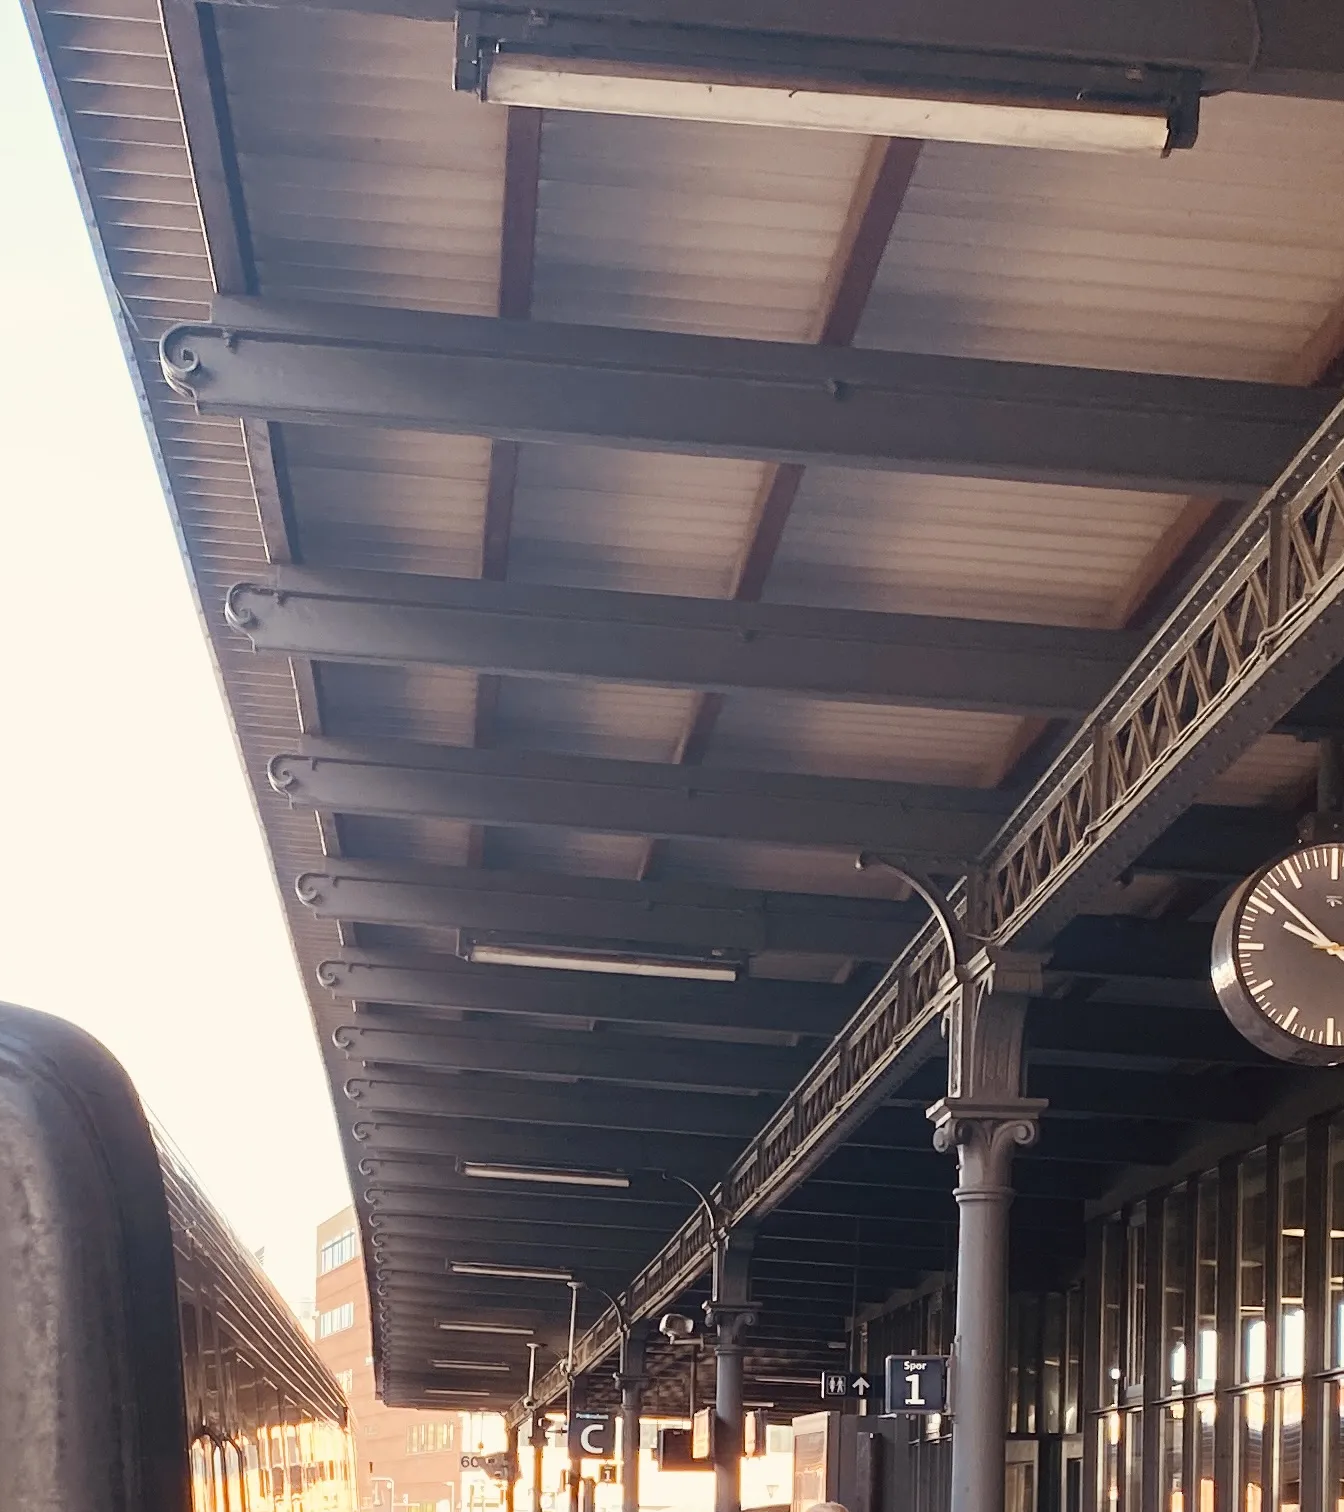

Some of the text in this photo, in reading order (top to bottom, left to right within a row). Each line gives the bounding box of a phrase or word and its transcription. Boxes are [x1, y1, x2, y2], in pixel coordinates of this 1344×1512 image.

[903, 1360, 927, 1372] Spor
[905, 1373, 926, 1405] 1
[580, 1423, 604, 1454] C
